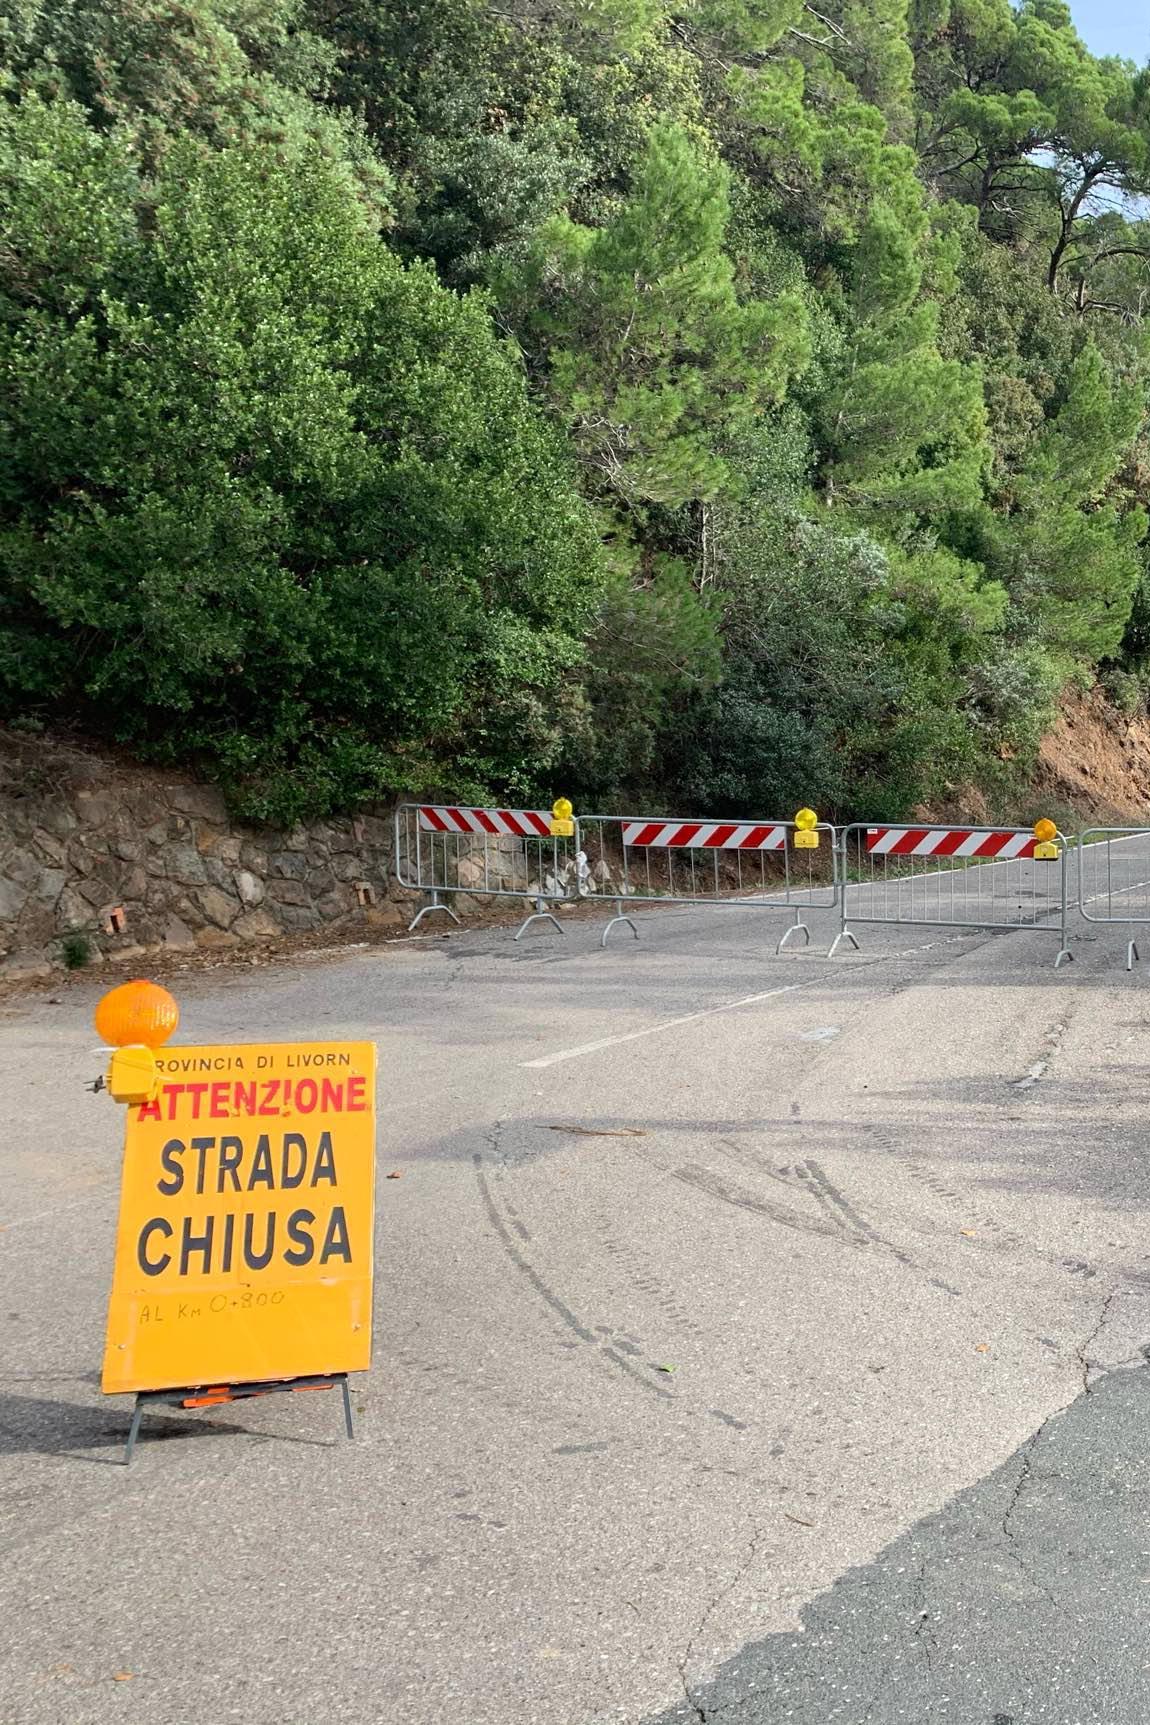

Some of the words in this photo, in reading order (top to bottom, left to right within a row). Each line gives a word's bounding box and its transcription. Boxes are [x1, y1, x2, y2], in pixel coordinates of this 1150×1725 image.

[154, 1056, 245, 1073] ROVINCIA
[257, 1056, 274, 1069] DI
[157, 1131, 339, 1196] STRADA
[137, 1206, 353, 1276] CHIUSA
[139, 1305, 163, 1325] AL
